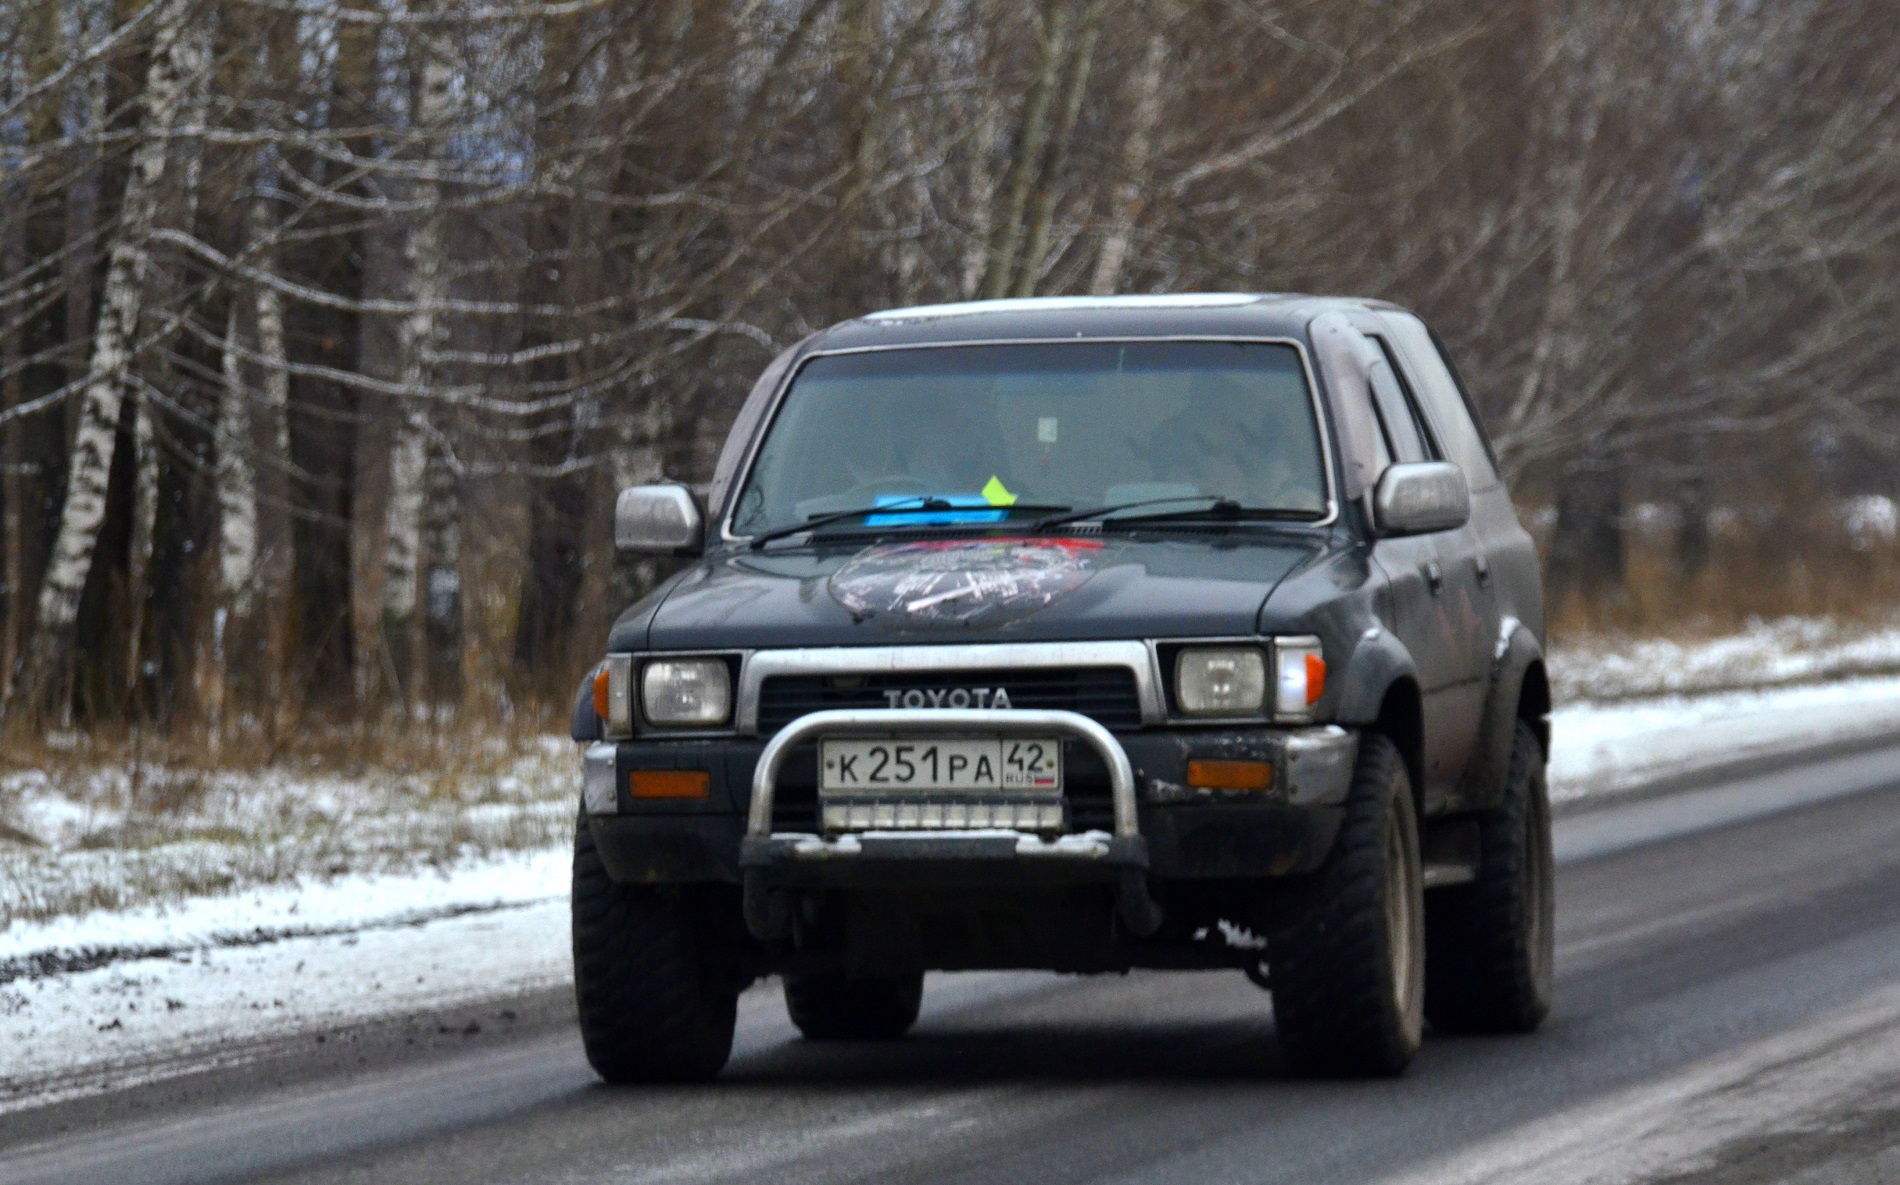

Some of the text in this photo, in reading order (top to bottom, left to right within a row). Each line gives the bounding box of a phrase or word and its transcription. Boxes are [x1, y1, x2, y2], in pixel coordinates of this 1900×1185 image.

[883, 687, 1013, 709] TOYOTA
[1007, 743, 1045, 772] 42
[1005, 774, 1033, 784] RUS
